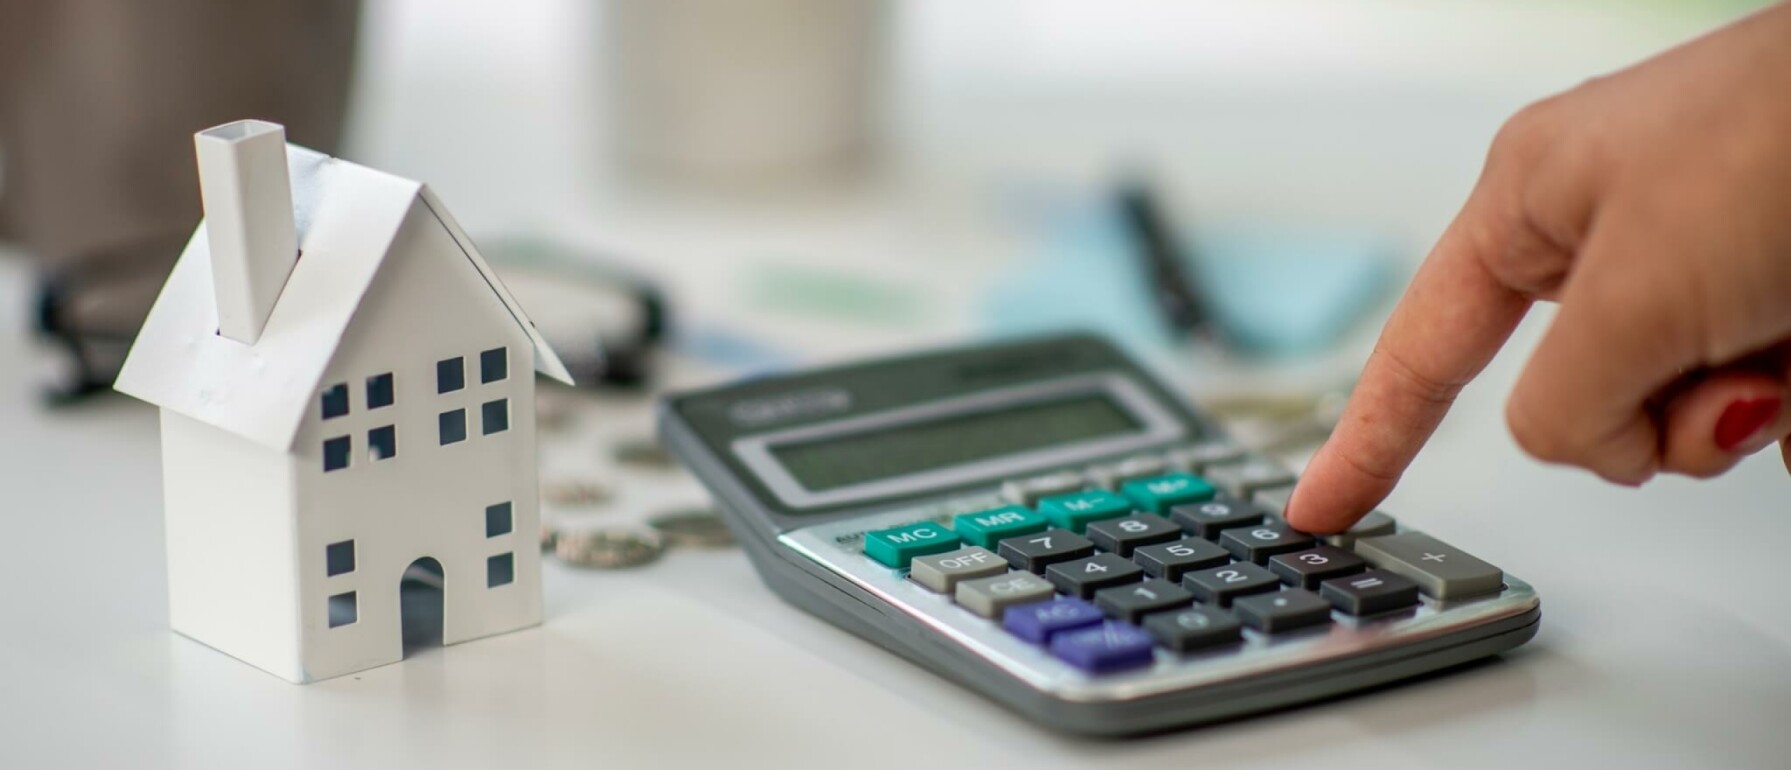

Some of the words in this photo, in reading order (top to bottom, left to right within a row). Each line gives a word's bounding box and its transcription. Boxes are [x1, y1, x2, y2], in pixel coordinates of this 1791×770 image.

[1064, 497, 1105, 511] M-
[1201, 502, 1231, 516] 9
[976, 511, 1025, 527] MR
[1119, 520, 1149, 533] 8
[887, 528, 937, 544] MC
[1252, 527, 1281, 541] 6
[1030, 537, 1053, 549] 7
[1166, 543, 1195, 557] 5
[939, 551, 989, 569] OFF
[1299, 553, 1329, 565] 3
[1421, 552, 1446, 564] +
[1085, 562, 1108, 574] 4
[1216, 569, 1249, 584] 2
[1351, 577, 1384, 590] =
[990, 577, 1036, 594] CE
[1134, 586, 1157, 600] 1
[1177, 611, 1209, 630] 0
